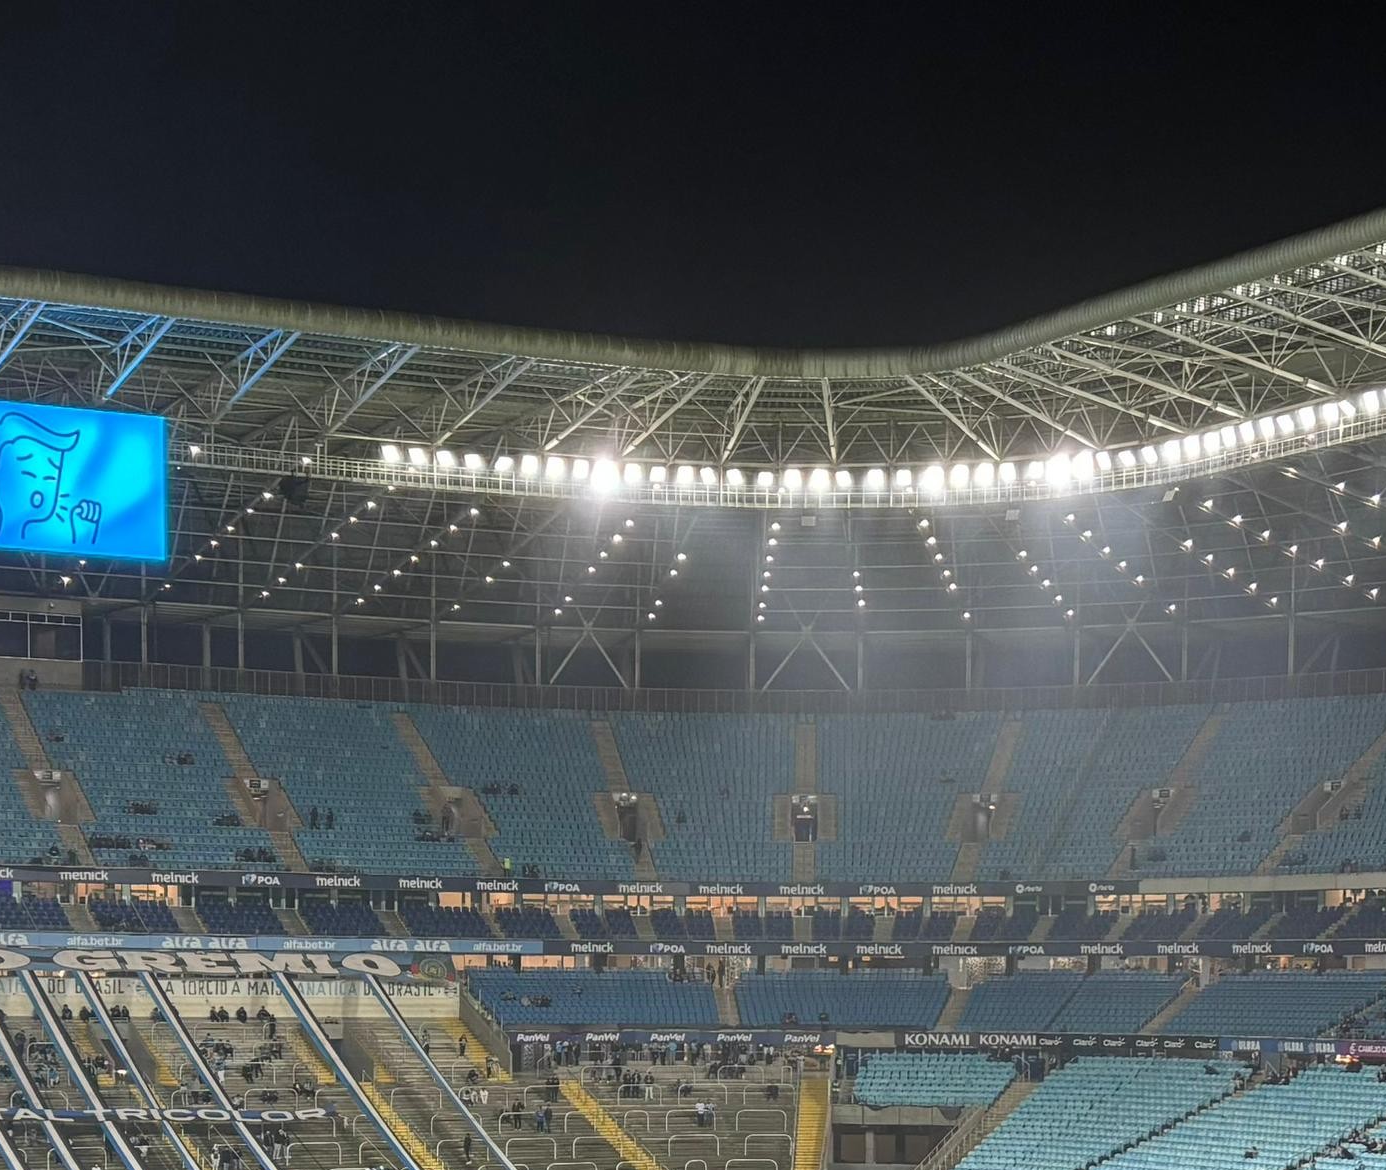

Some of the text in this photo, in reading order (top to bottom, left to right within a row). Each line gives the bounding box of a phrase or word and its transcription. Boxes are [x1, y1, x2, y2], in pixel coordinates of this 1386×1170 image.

[58, 869, 109, 881] melnick
[476, 879, 519, 891] melnick
[553, 881, 581, 893] POA
[618, 882, 664, 894] melnick
[66, 933, 126, 948] alfa.bet.br
[370, 938, 454, 953] alfa alfa
[469, 940, 524, 953] alfa.bet.br
[570, 941, 614, 953] melnick
[660, 942, 686, 954] POA
[705, 942, 752, 955] melnick
[1080, 943, 1124, 955] melnick
[1156, 942, 1199, 954] melnick
[1312, 942, 1334, 954] POA
[74, 978, 124, 994] BASIL
[165, 981, 175, 995] A
[182, 980, 241, 996] TORCIDA
[388, 982, 434, 998] BRASIL
[585, 1032, 620, 1042] PanVel
[716, 1033, 753, 1042] PanVel
[904, 1033, 1037, 1046] KONAMI KONAMI
